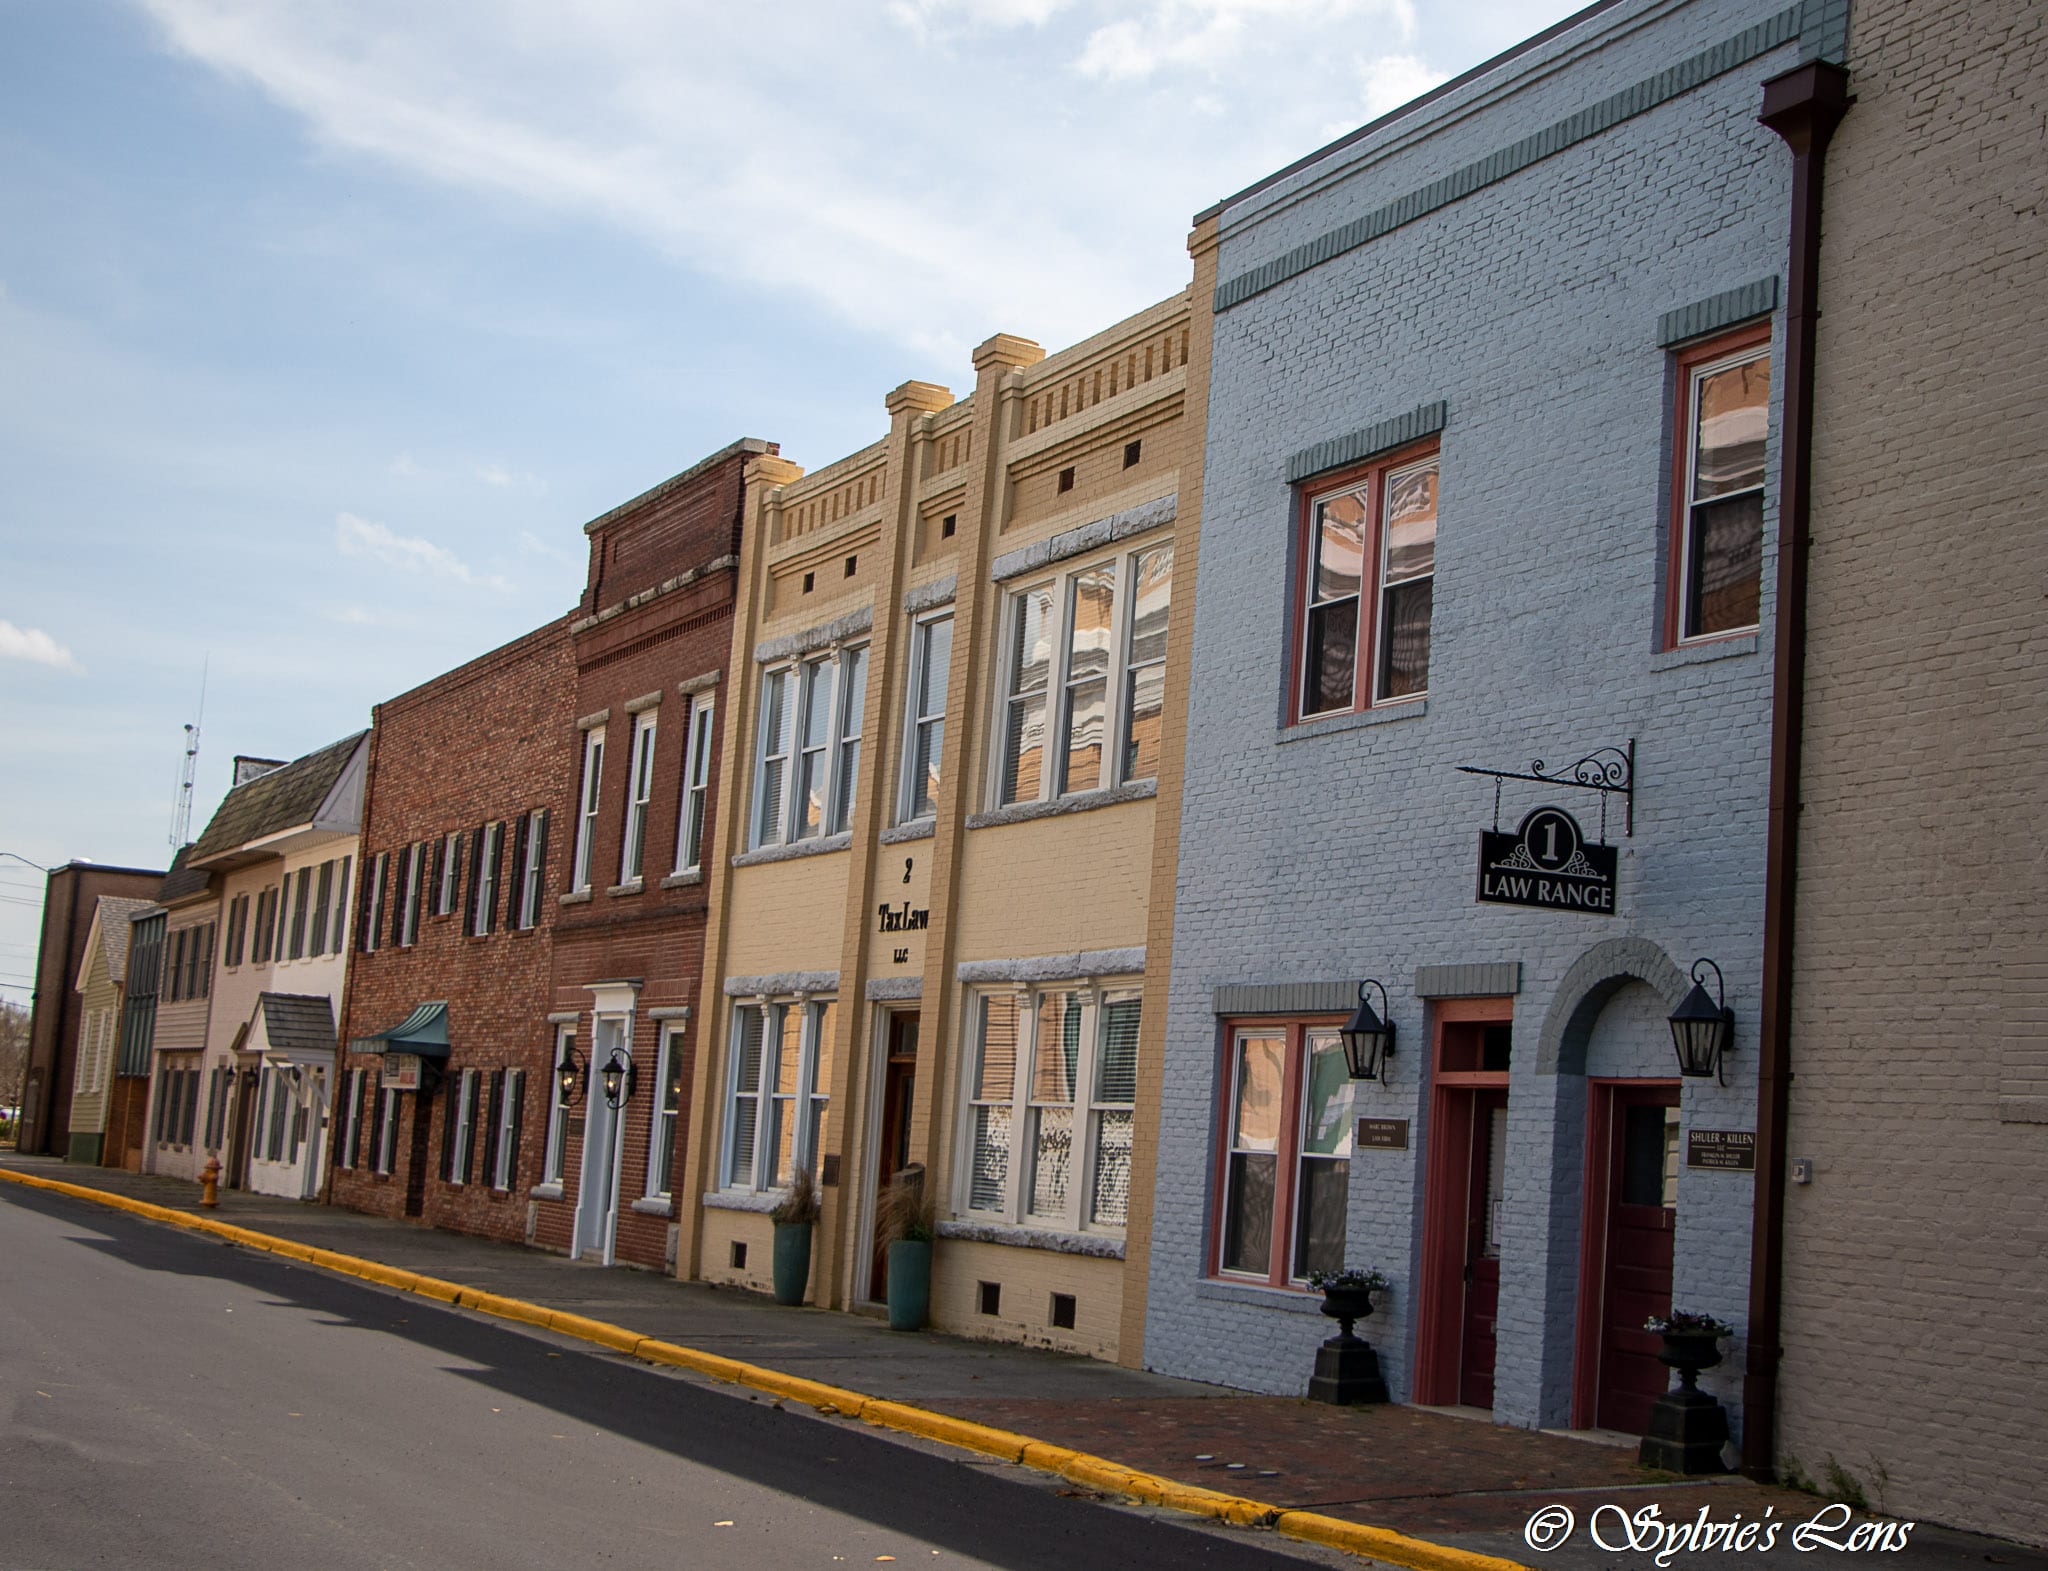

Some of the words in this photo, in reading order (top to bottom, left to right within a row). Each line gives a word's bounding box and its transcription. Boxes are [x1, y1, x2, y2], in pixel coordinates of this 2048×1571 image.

[1541, 821, 1559, 861] 1
[902, 857, 913, 884] 2
[1484, 873, 1533, 899] LAW
[1538, 879, 1612, 908] RANGE
[1691, 1131, 1720, 1143] SHULER
[1726, 1133, 1753, 1144] KILLEN
